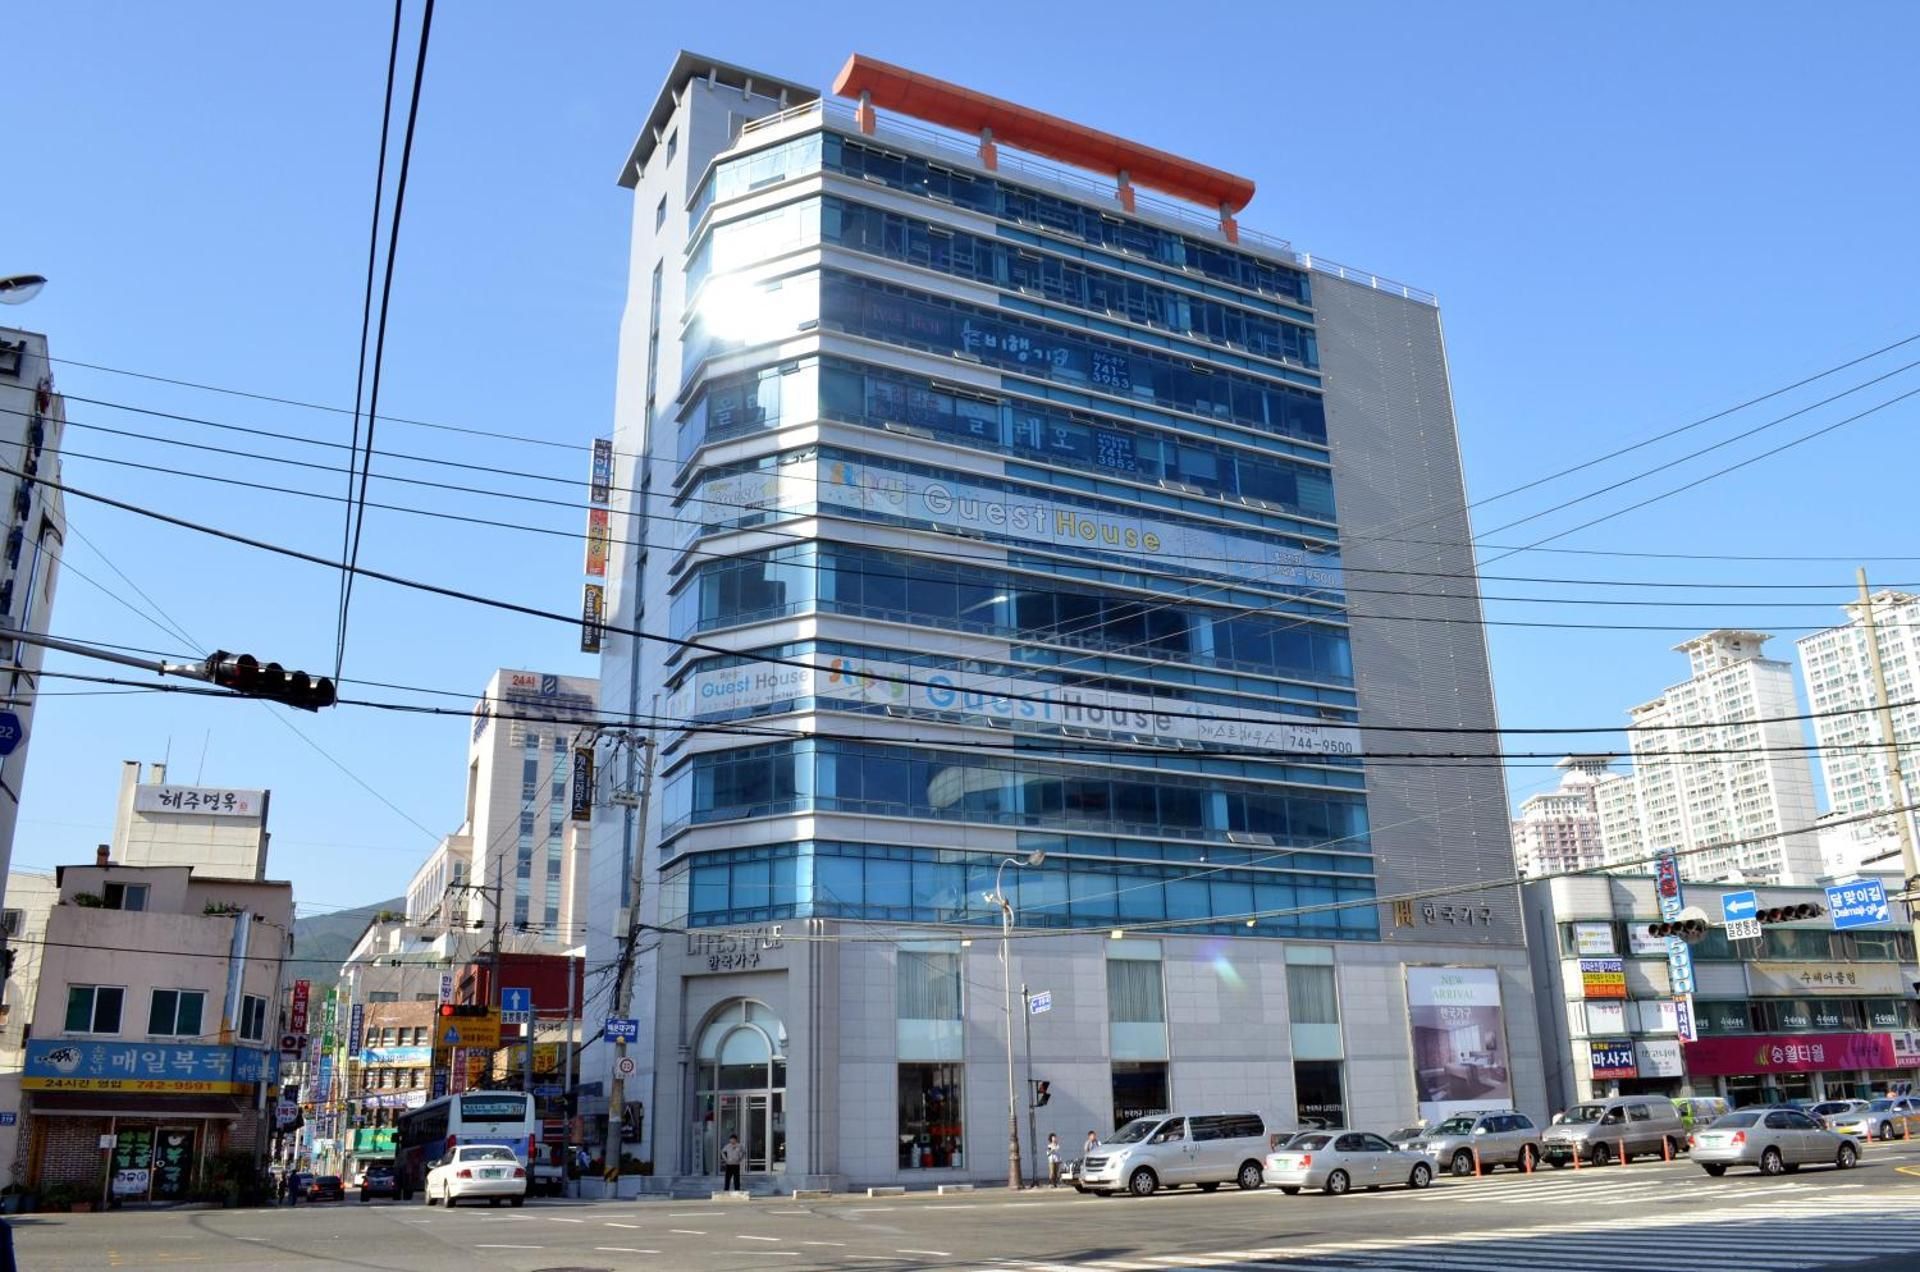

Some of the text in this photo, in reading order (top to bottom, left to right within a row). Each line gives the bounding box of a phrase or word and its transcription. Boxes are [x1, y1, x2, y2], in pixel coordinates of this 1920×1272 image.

[923, 483, 1045, 533] Guest
[1055, 510, 1160, 551] House
[701, 676, 750, 699] Guest
[755, 670, 809, 690] House
[926, 675, 1053, 719] Guest
[1063, 693, 1173, 731] House
[1289, 735, 1354, 753] 744-9500
[158, 789, 237, 812] 해주면옥
[1830, 886, 1881, 908] 달맞이길
[1440, 976, 1465, 985] NEW
[1433, 990, 1474, 1000] ARRIVAL
[1677, 1003, 1691, 1036] 마사지
[112, 1048, 232, 1075] 매일복국
[1592, 1051, 1633, 1067] 마사지
[1771, 1044, 1825, 1064] 송월타월
[45, 1078, 90, 1089] 24시간
